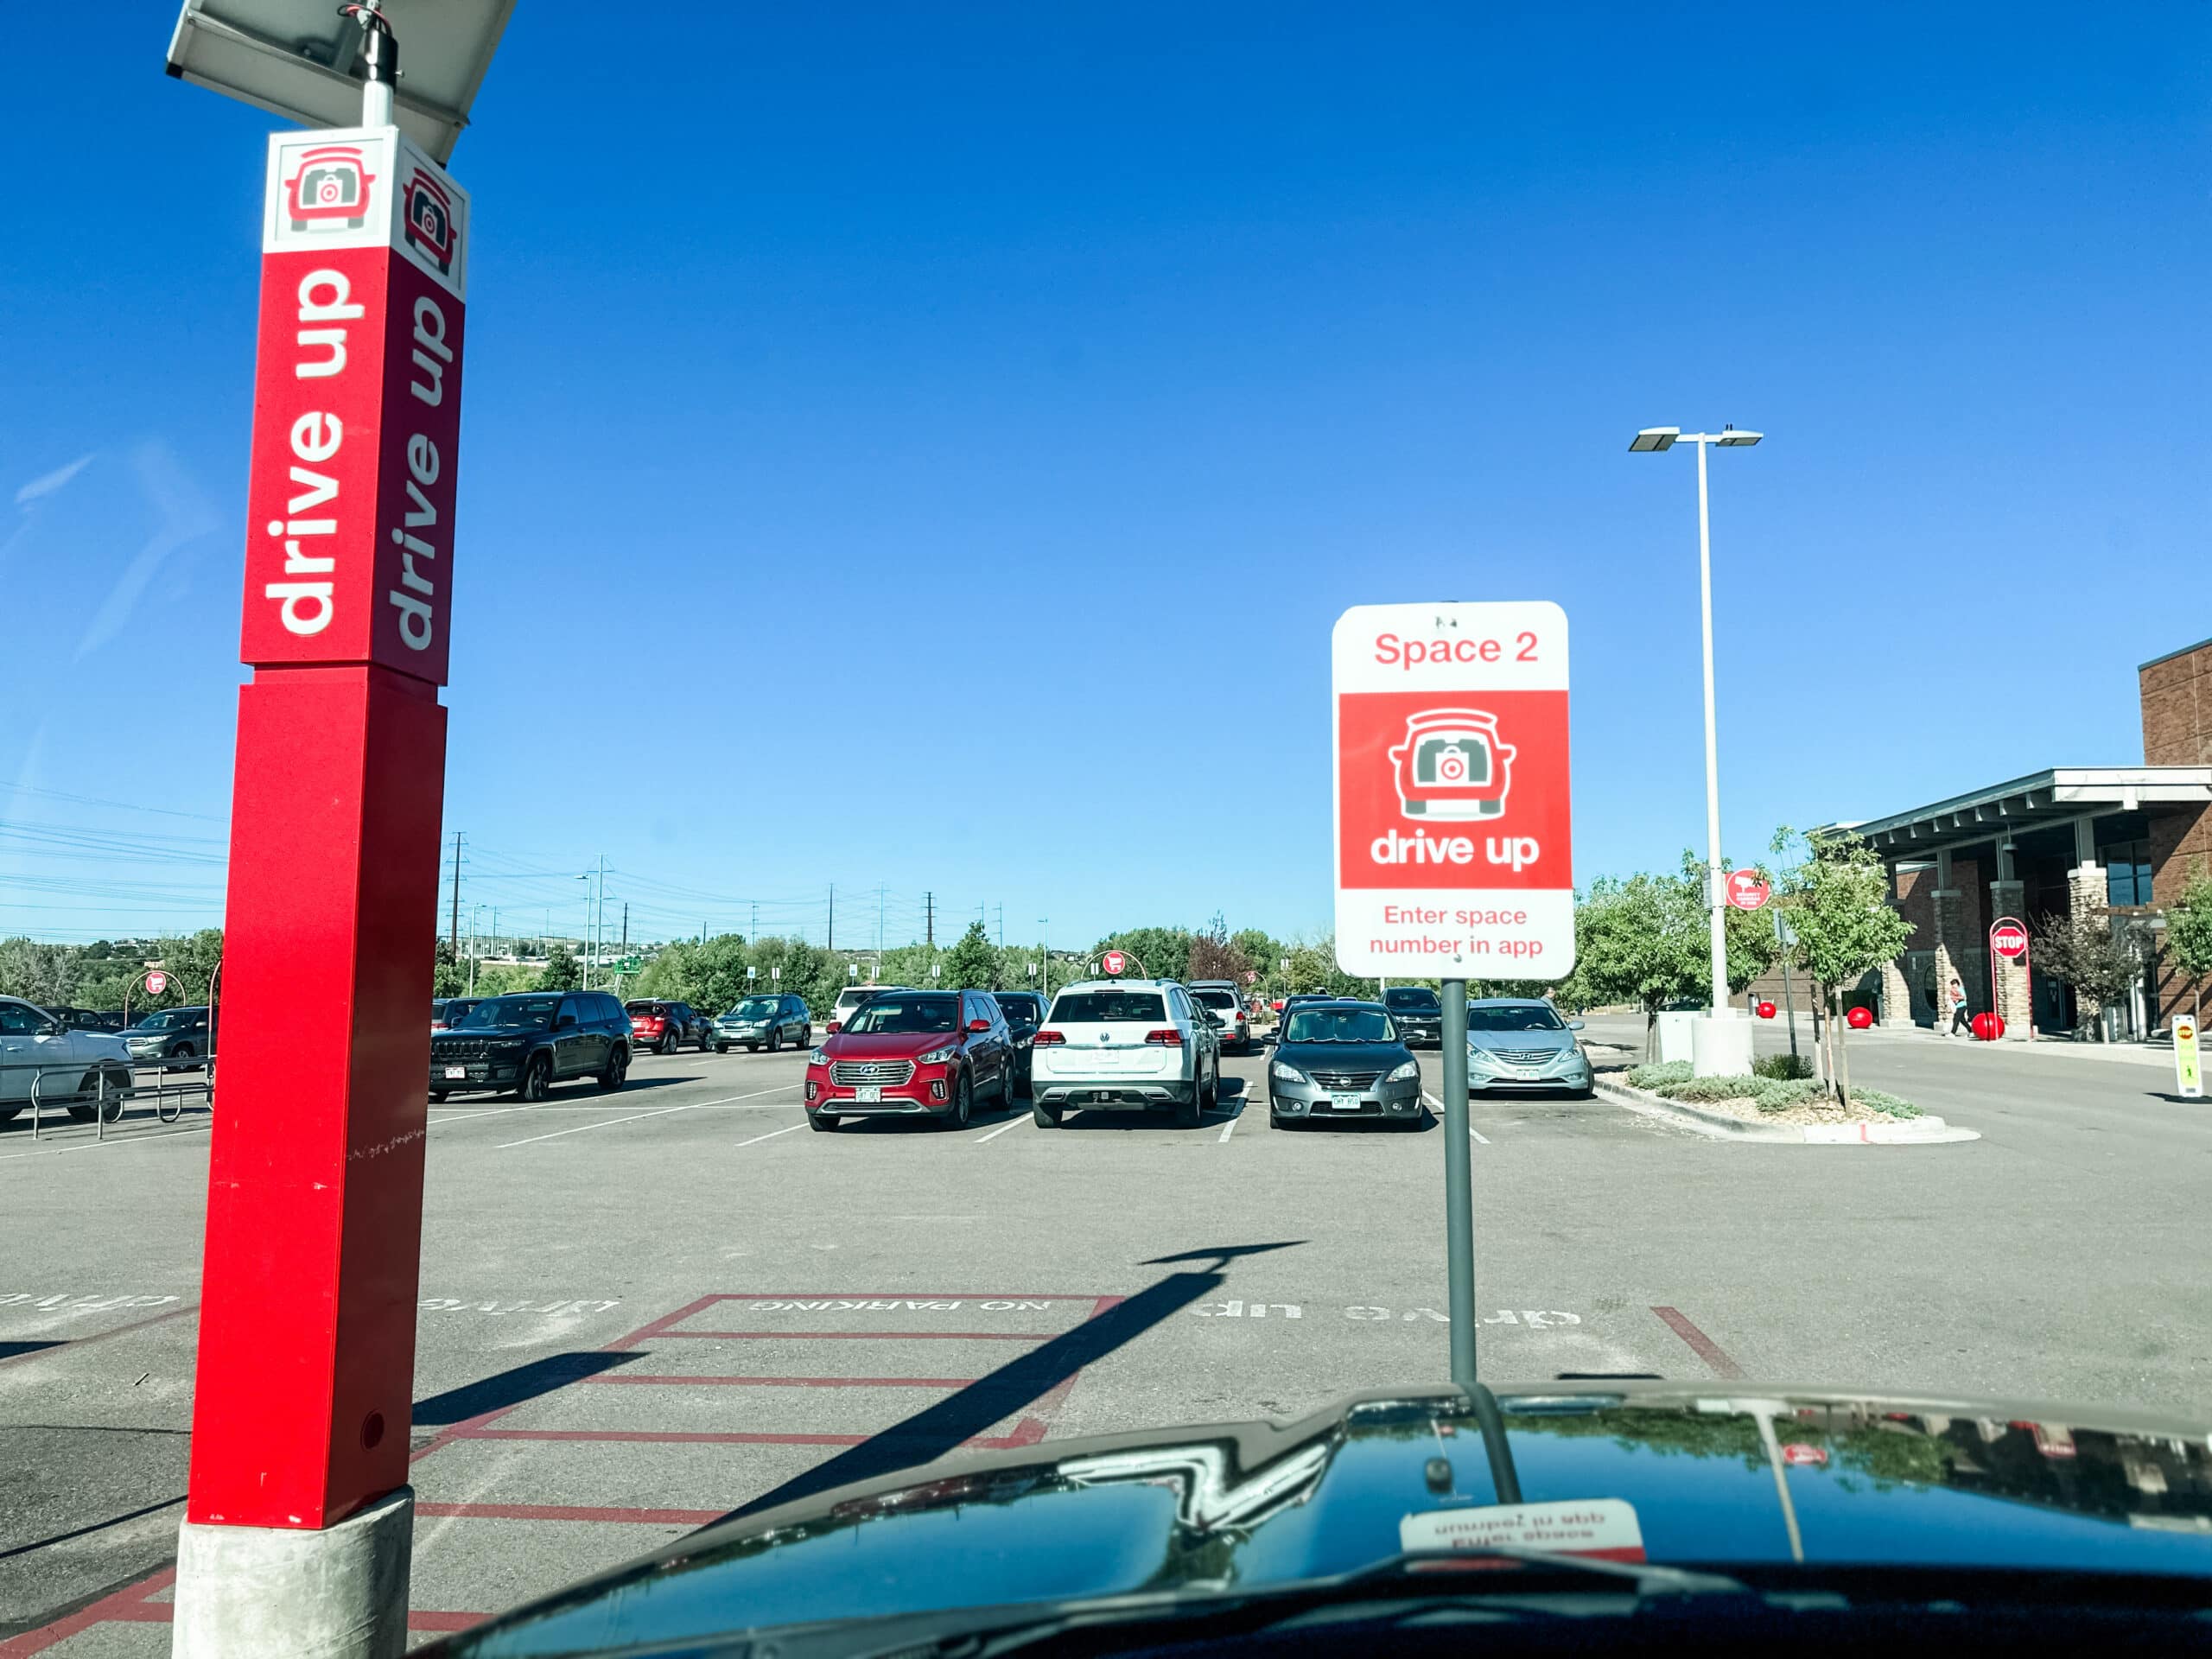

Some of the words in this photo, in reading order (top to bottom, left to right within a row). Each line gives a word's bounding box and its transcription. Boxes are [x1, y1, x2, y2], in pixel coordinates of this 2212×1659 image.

[296, 269, 365, 380] up
[410, 296, 454, 407] up
[265, 410, 343, 635] drive
[390, 433, 440, 651] drive
[1375, 632, 1502, 671] Space
[1516, 632, 1538, 662] 2
[1370, 828, 1474, 865] drive
[1486, 836, 1540, 873] up
[1384, 906, 1446, 924] Enter
[1455, 911, 1527, 928] space
[1370, 936, 1461, 954] number
[1471, 936, 1492, 954] in
[1499, 938, 1543, 958] app
[1995, 936, 2024, 949] STOP
[748, 1301, 962, 1311] PARKING
[980, 1301, 1051, 1311] NO
[1189, 1300, 1302, 1319] up
[1344, 1305, 1581, 1329] drve
